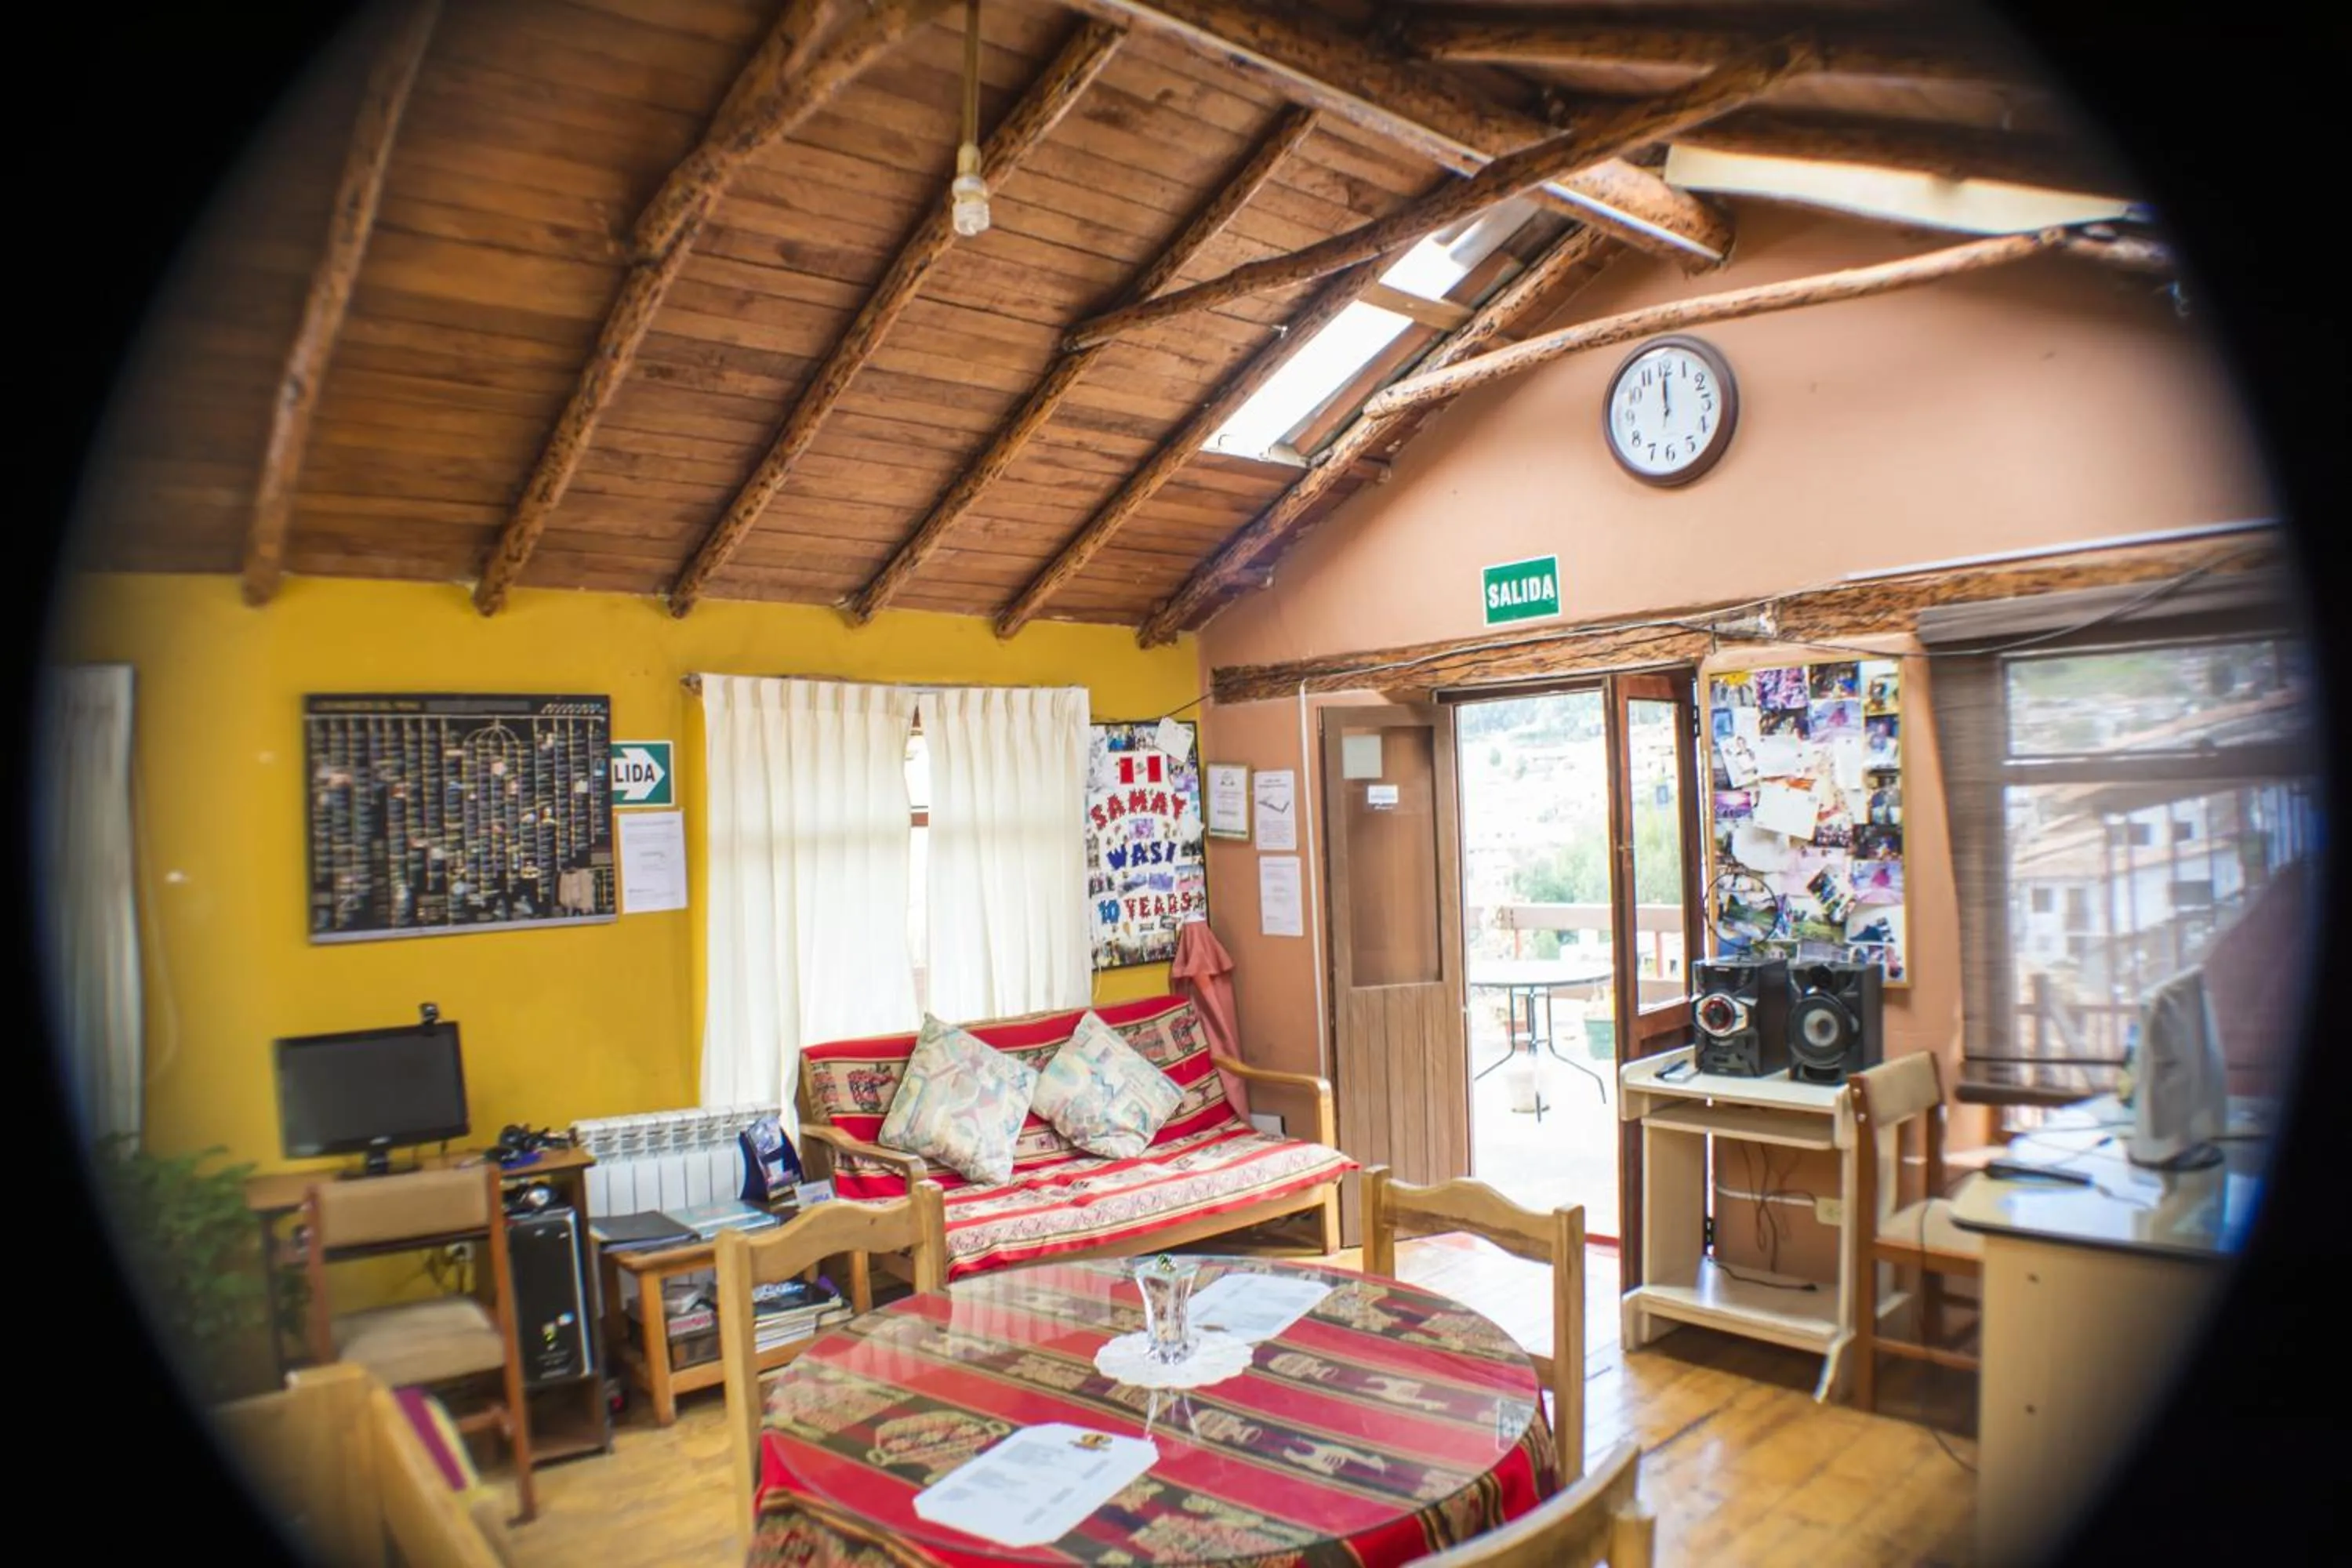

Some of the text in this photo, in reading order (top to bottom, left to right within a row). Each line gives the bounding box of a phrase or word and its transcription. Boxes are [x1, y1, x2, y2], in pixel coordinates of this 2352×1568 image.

[1642, 368, 1651, 387] 11
[1657, 360, 1671, 378] 12
[1682, 361, 1686, 379] 1
[1694, 372, 1705, 391] 2
[1628, 387, 1642, 406] 10
[1625, 409, 1635, 426] 9
[1632, 430, 1641, 448] 8
[1685, 434, 1696, 452] 5
[1647, 442, 1656, 461] 7
[1665, 443, 1675, 463] 6
[1487, 573, 1555, 609] SALIDA
[614, 763, 655, 783] LIDA
[1091, 789, 1187, 829] SAMAY
[1106, 840, 1176, 871] WASI
[1098, 899, 1120, 924] 10
[1123, 891, 1192, 921] YEARS
